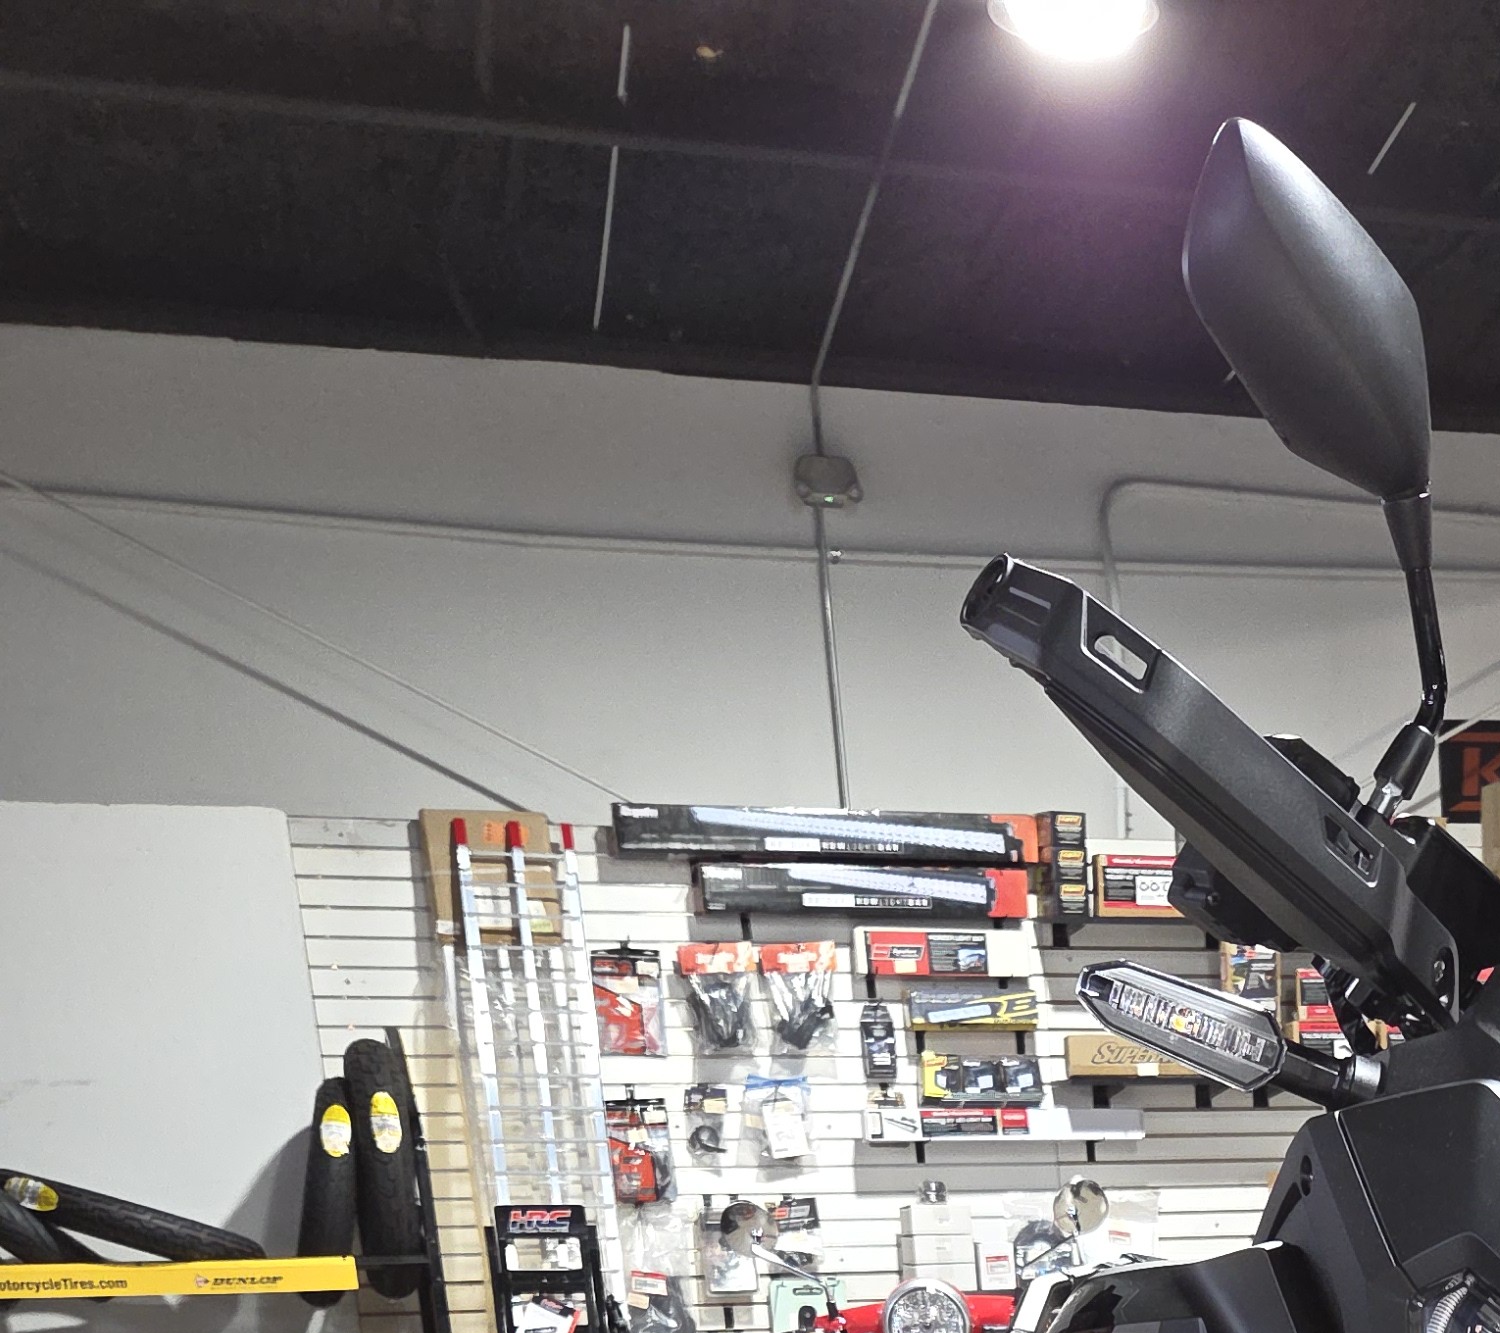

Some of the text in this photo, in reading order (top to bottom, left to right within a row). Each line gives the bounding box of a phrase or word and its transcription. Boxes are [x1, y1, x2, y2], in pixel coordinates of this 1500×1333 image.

[510, 1209, 572, 1232] HRC
[0, 1278, 128, 1291] otorcycleTires.com
[211, 1275, 284, 1287] DUNLOP
